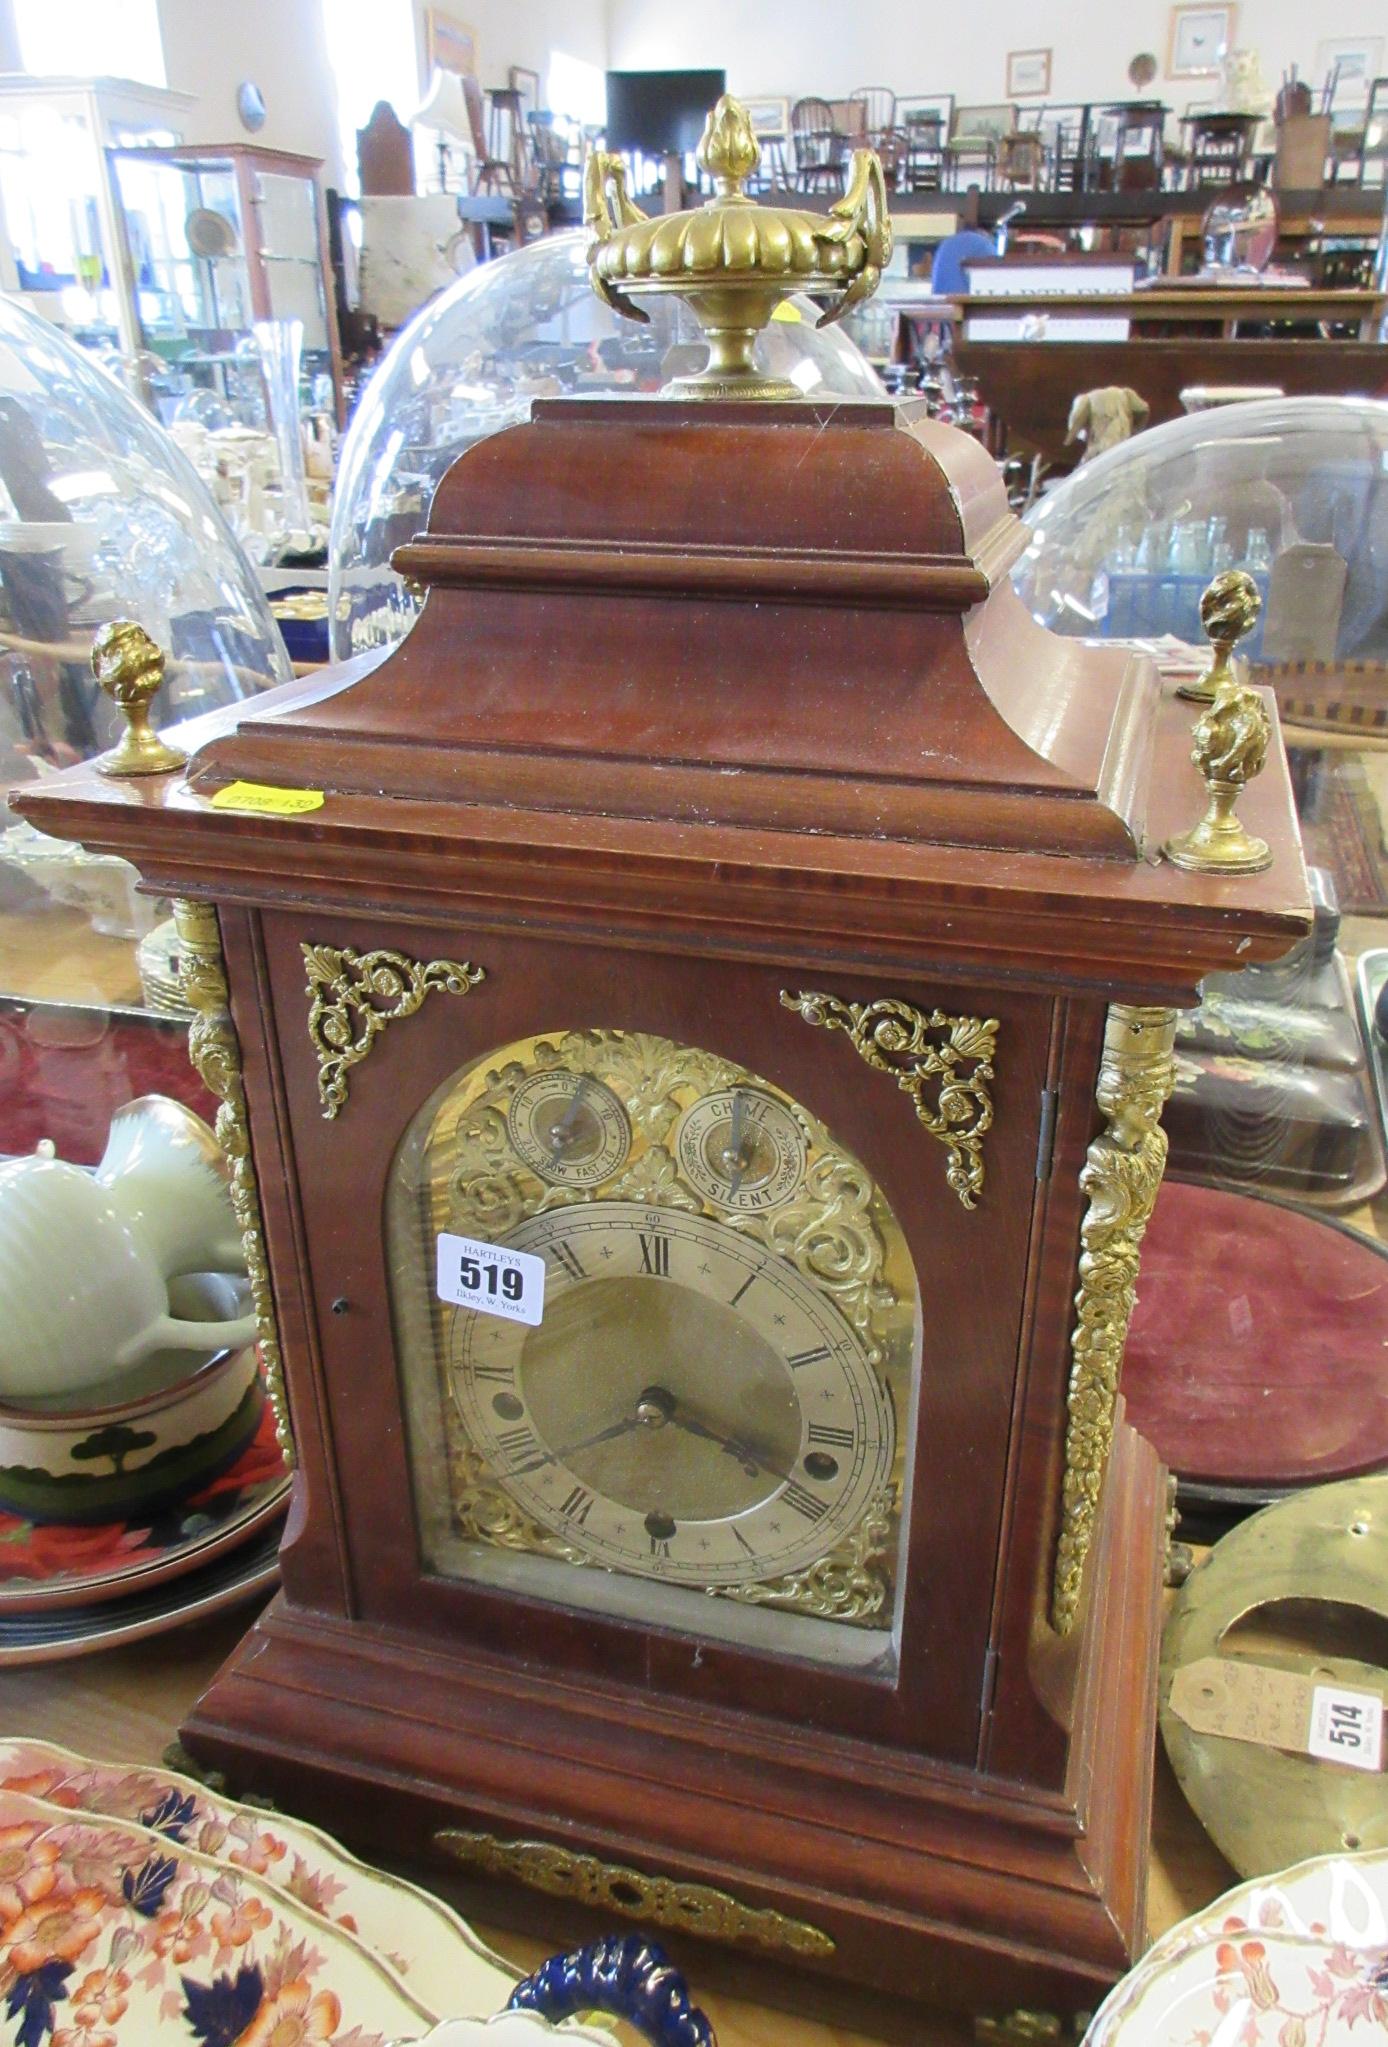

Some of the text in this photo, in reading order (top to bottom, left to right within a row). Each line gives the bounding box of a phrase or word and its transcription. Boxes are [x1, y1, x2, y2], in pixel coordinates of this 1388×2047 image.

[521, 1095, 533, 1109] 10
[602, 1108, 614, 1121] 10
[523, 1139, 536, 1153] 20
[602, 1150, 615, 1165] 20
[576, 1164, 601, 1178] FAST
[645, 1213, 661, 1224] 60
[464, 1245, 522, 1267] HARTLEYS
[637, 1233, 673, 1279] XII
[460, 1256, 524, 1301] 519
[500, 1300, 527, 1314] Yorks
[785, 1343, 833, 1370] II
[807, 1420, 855, 1451] III
[559, 1486, 595, 1526] VII
[1328, 1703, 1363, 1749] 514
